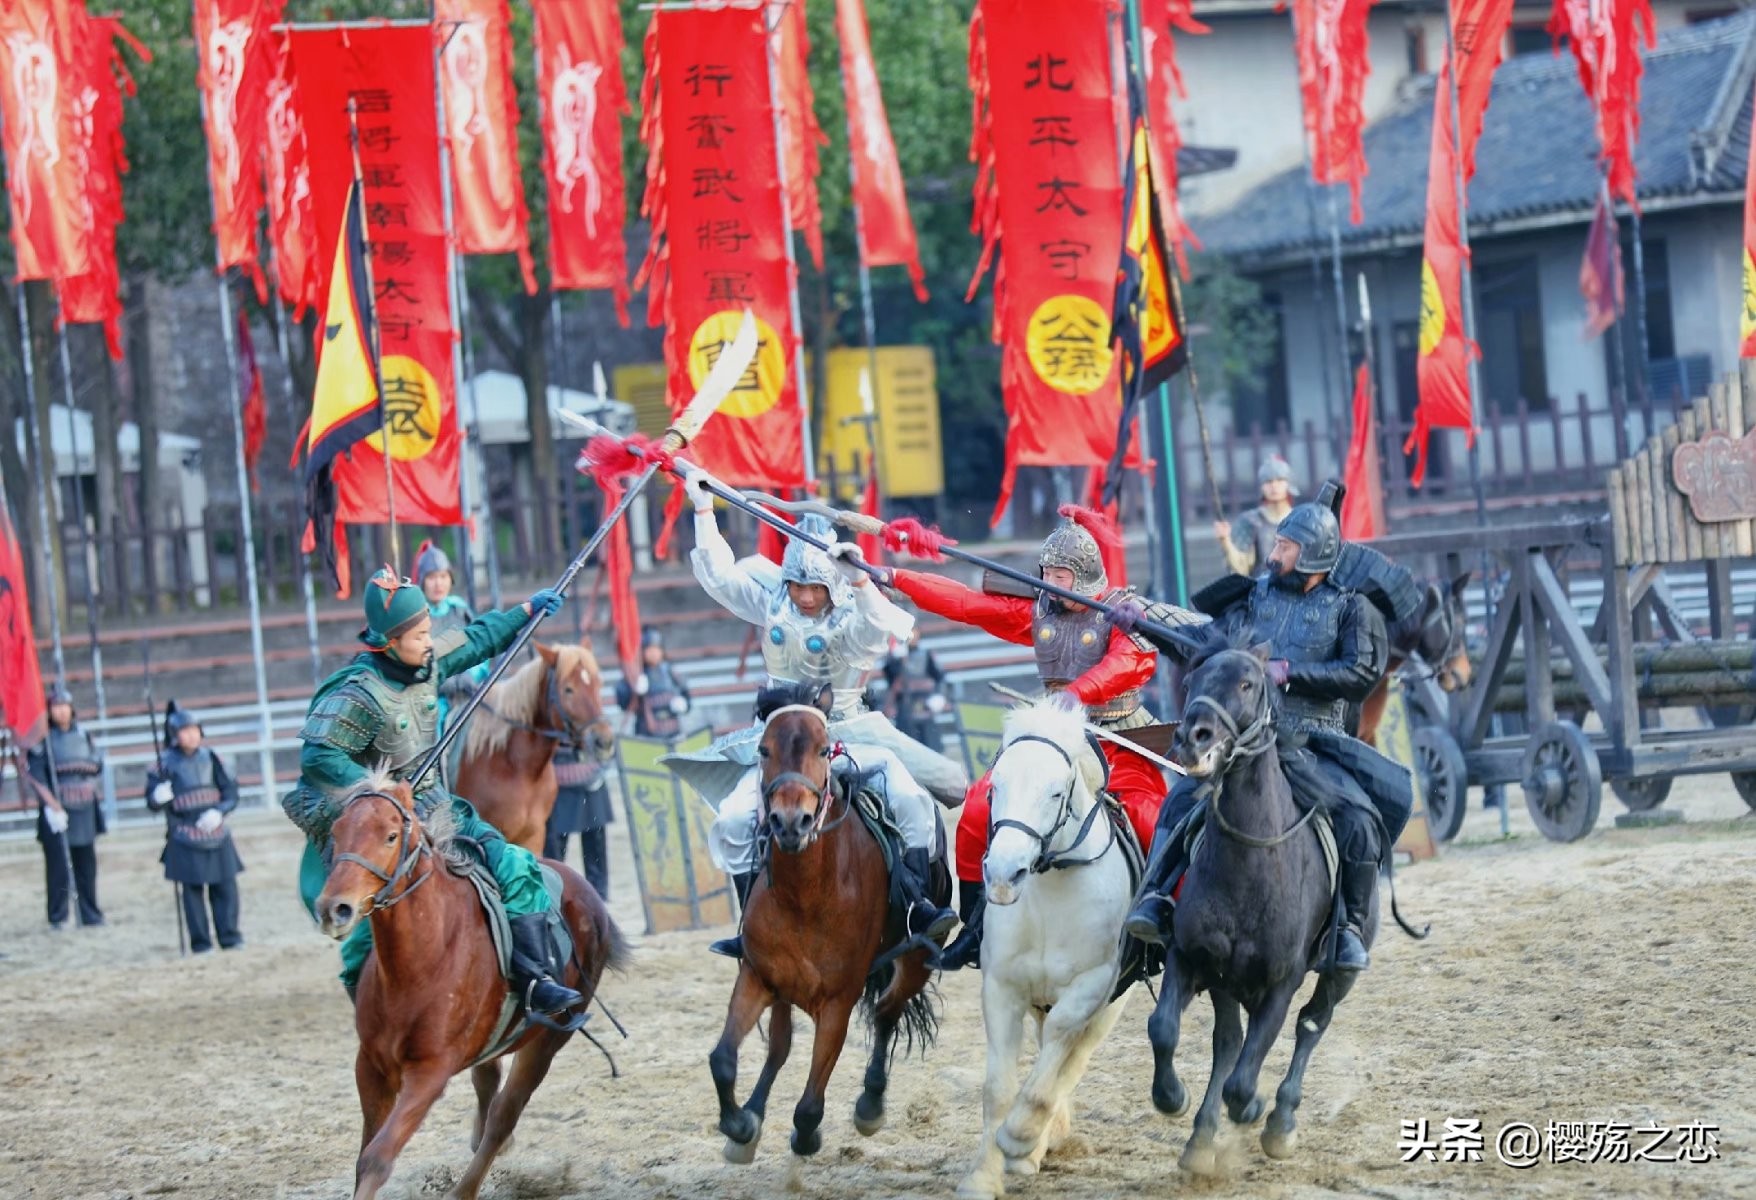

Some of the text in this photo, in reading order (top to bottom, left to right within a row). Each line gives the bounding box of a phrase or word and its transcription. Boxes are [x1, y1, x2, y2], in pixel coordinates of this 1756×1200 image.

[1024, 53, 1091, 281] 北平太守
[1040, 313, 1101, 379] 公孫
